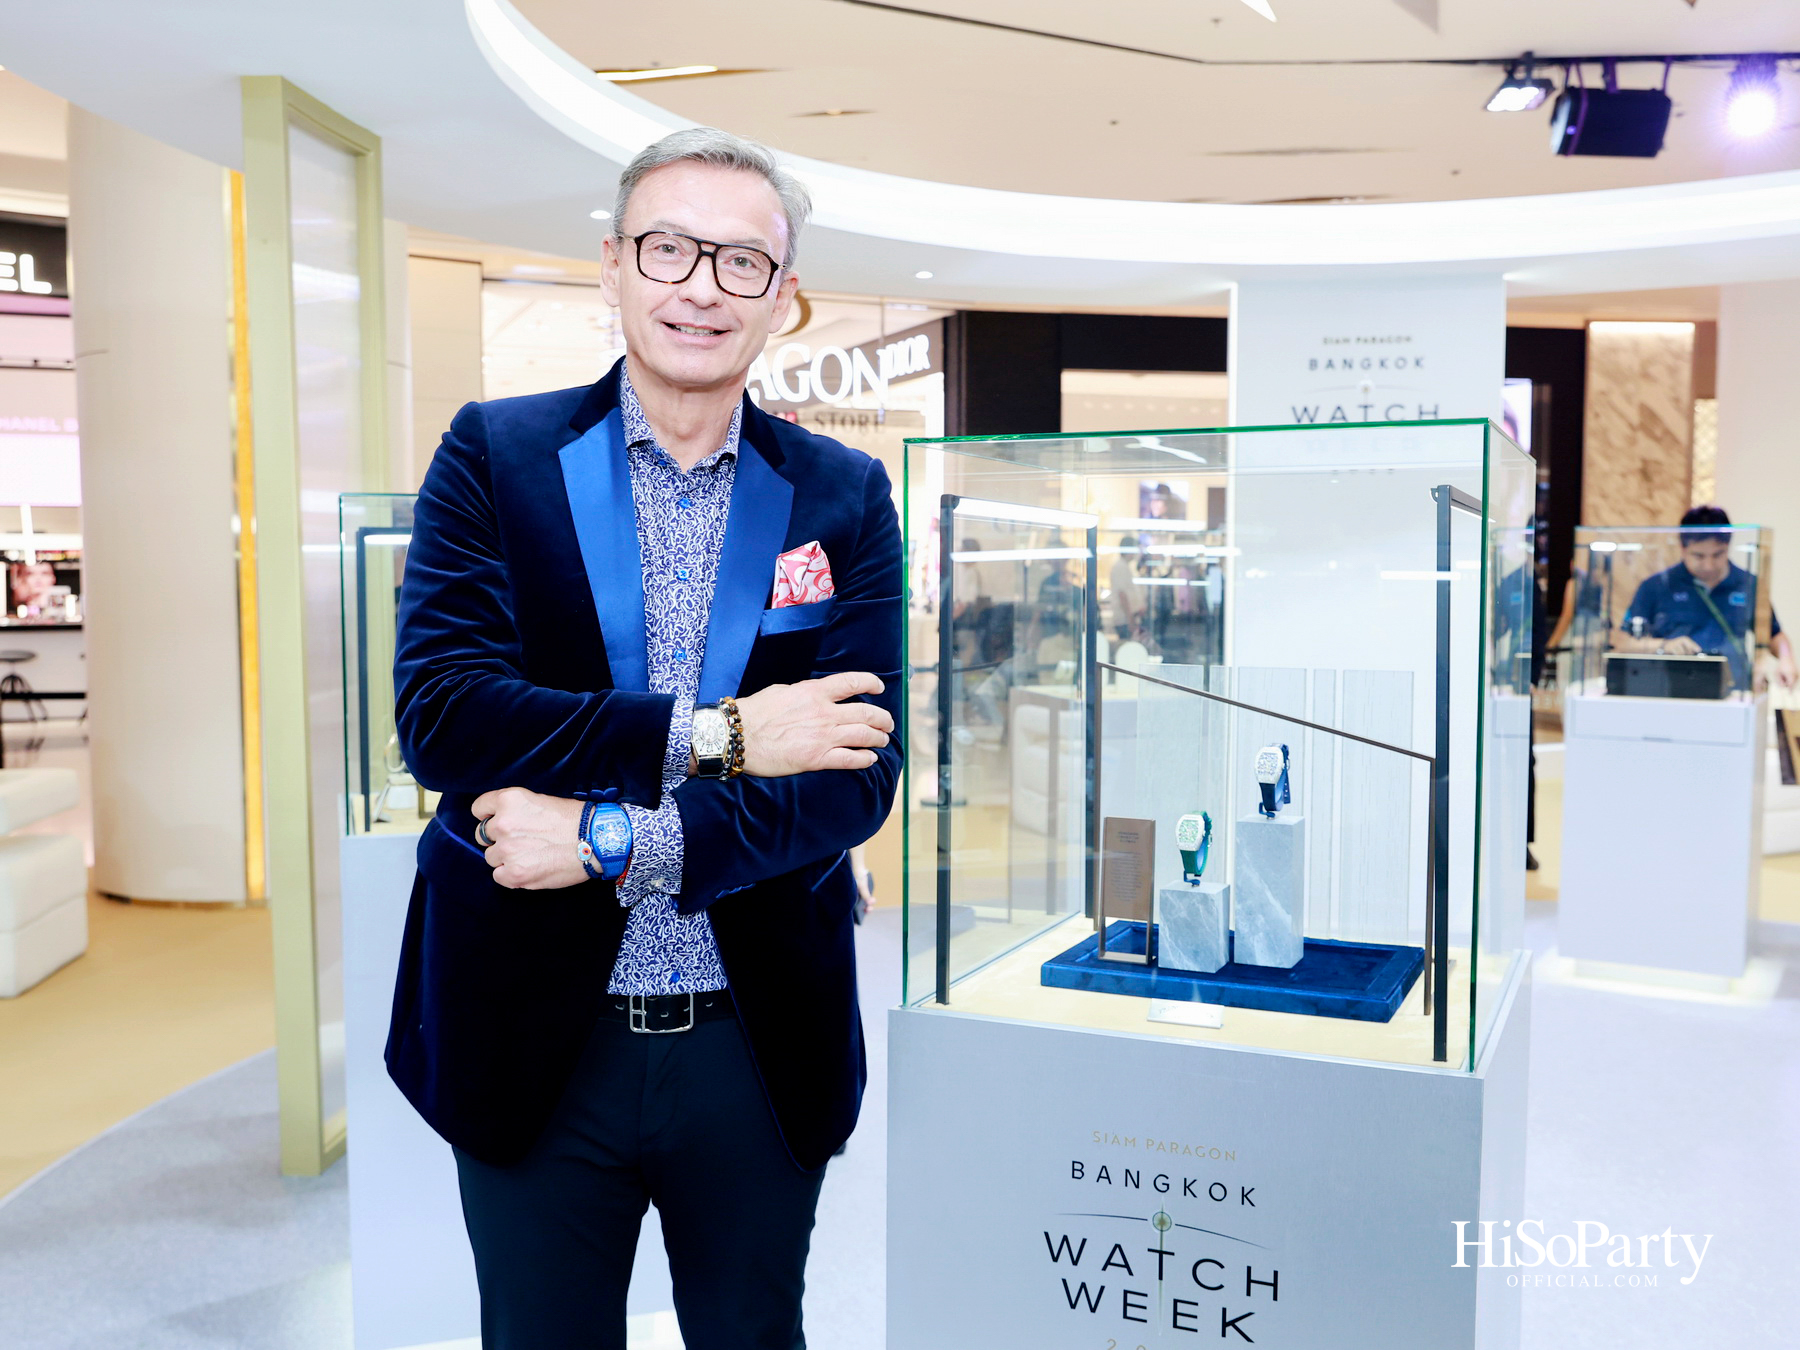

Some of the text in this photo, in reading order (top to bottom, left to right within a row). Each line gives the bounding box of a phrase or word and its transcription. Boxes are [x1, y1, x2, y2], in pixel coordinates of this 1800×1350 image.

[745, 342, 889, 409] AGON
[879, 334, 931, 379] DIOR
[1308, 357, 1425, 372] BANGKOK
[1291, 404, 1440, 424] WATCH
[1092, 1130, 1236, 1161] SIAM PARAGON
[1071, 1160, 1256, 1207] BANGKOK
[1043, 1231, 1279, 1301] WATCH
[1061, 1278, 1256, 1344] WEEK
